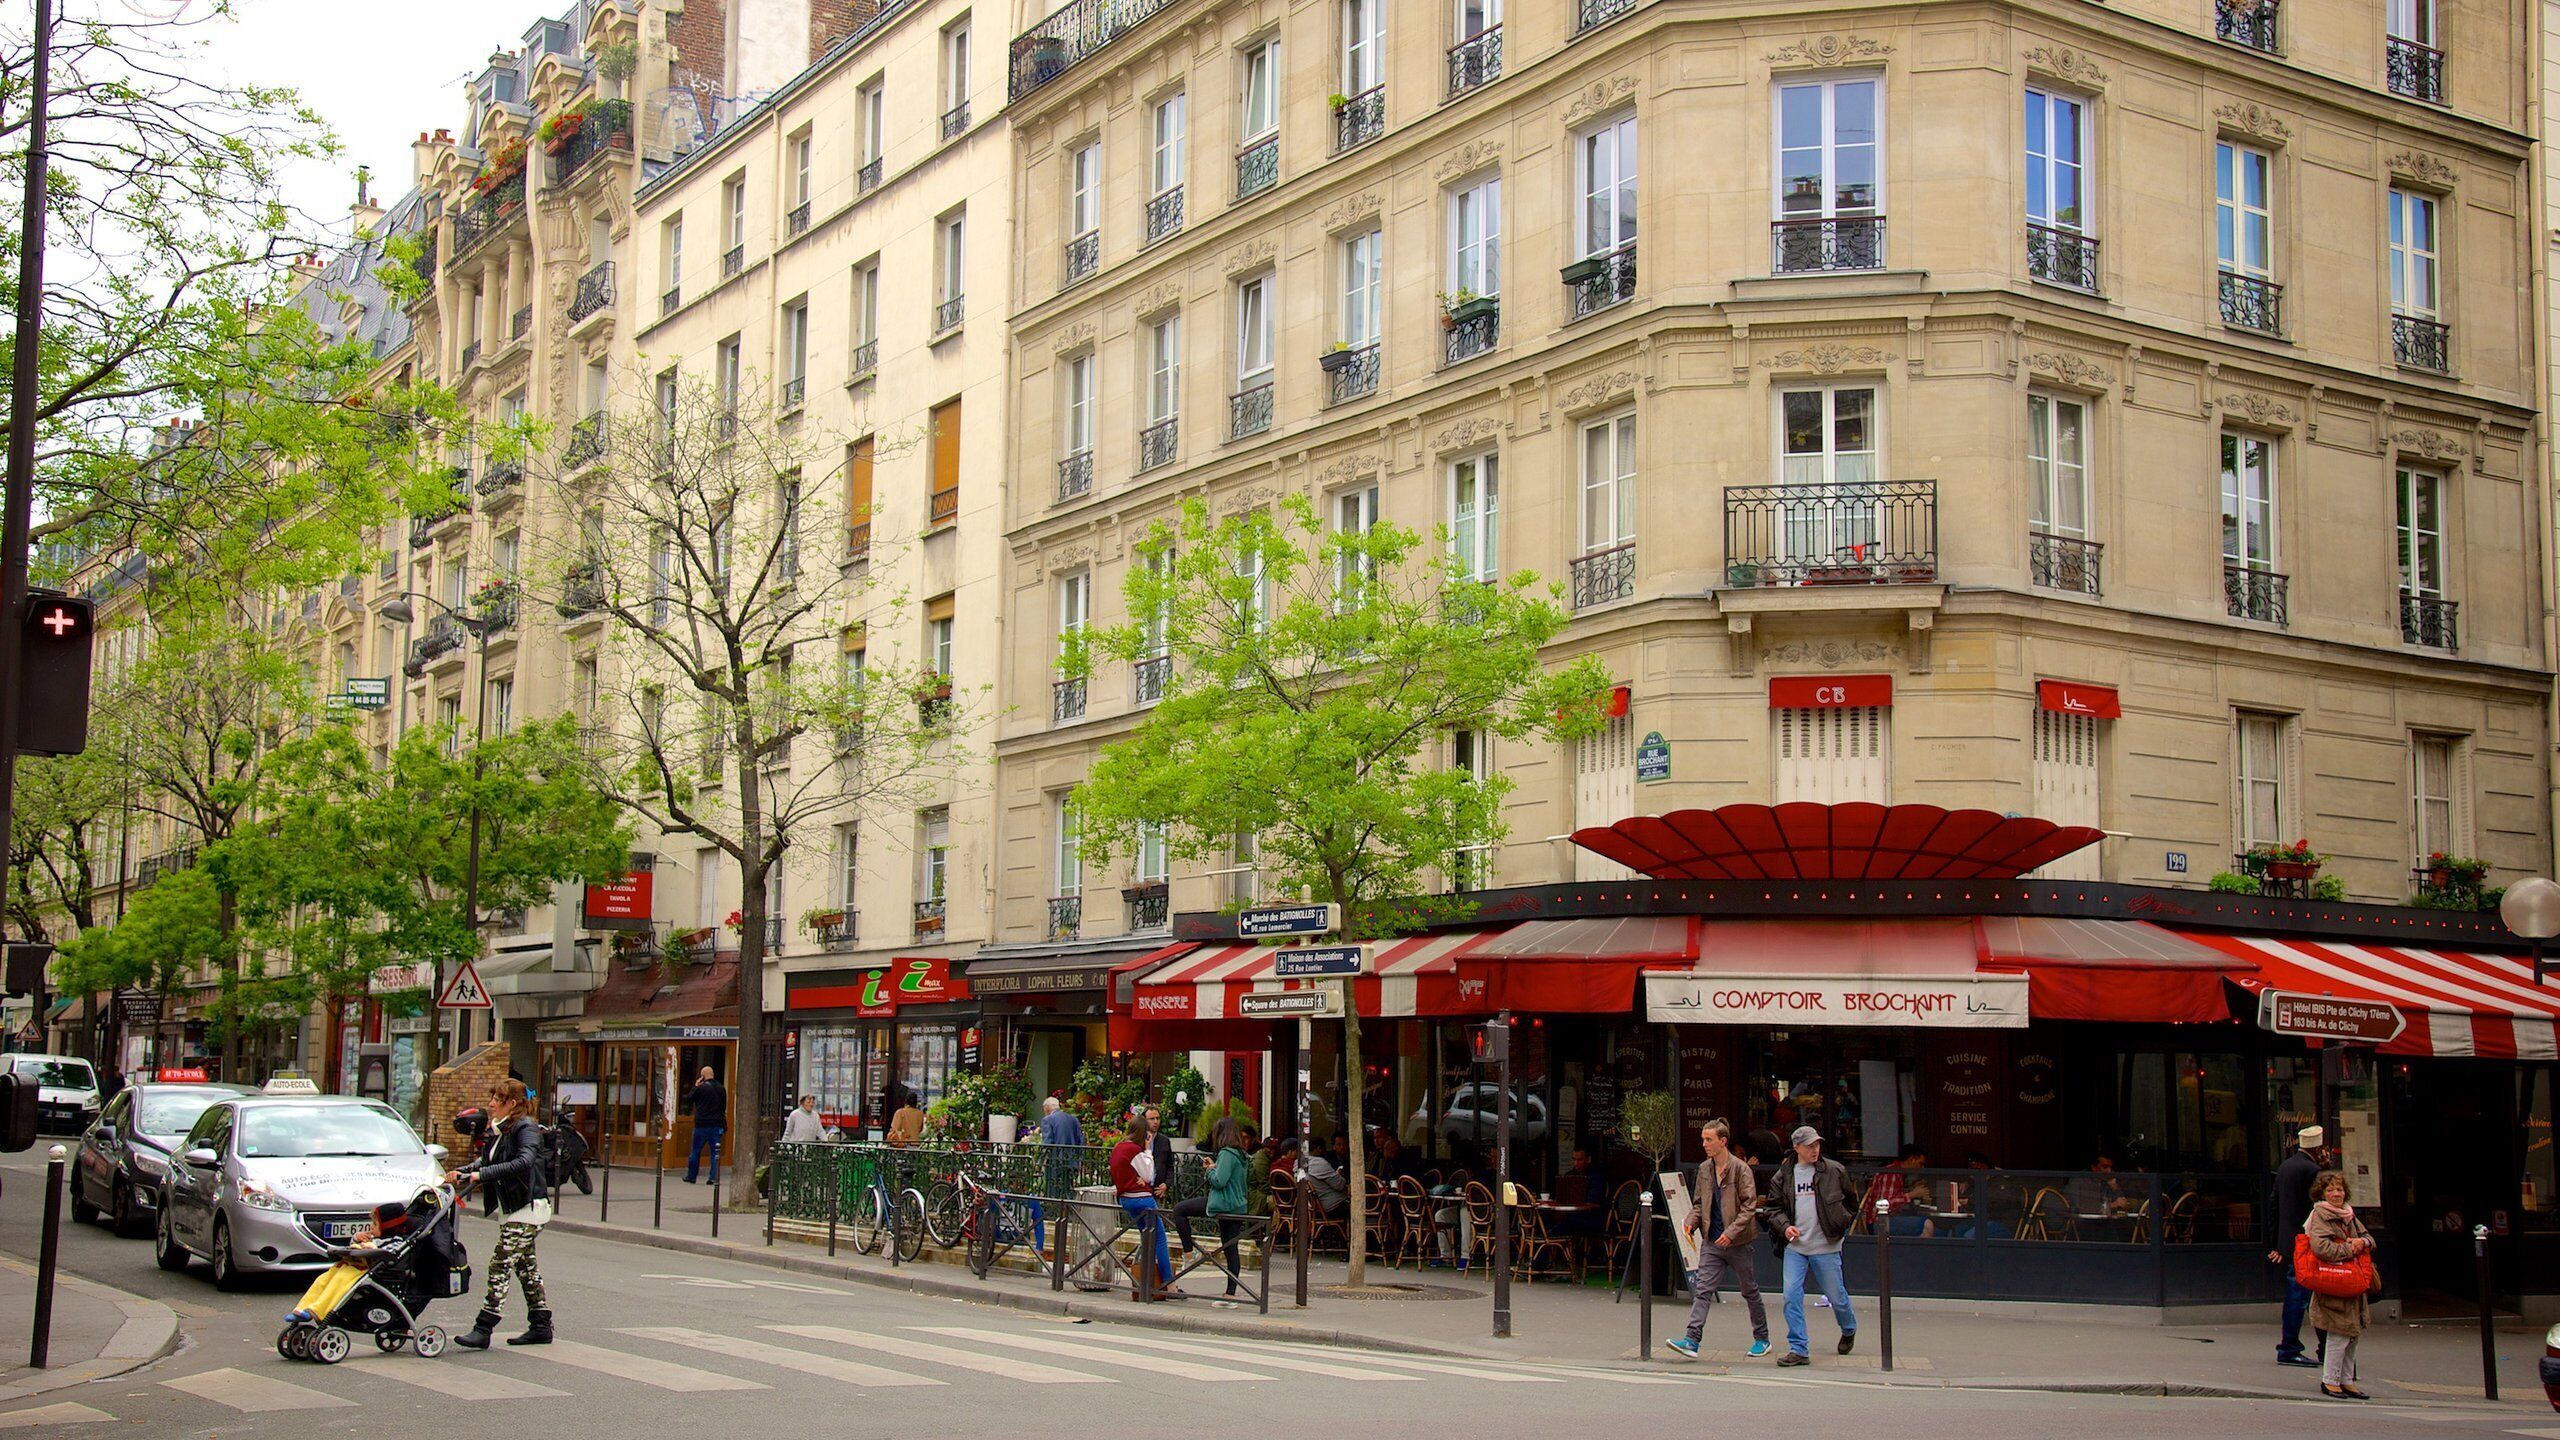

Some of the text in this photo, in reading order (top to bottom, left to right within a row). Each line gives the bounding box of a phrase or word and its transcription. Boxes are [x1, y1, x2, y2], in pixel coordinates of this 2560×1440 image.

[1815, 686, 1847, 704] CB
[1647, 749, 1659, 757] RUE
[1638, 755, 1667, 766] BROCHANT
[2168, 853, 2186, 871] 129
[1251, 909, 1315, 923] Marché des BATIGNOLLES
[1268, 923, 1292, 931] Lemercier
[1288, 952, 1343, 962] Maison des Associations
[376, 965, 418, 988] PRESSING
[974, 977, 1021, 992] INTERFLORA
[1027, 975, 1055, 989] LOPHYL
[1056, 974, 1084, 988] FLEURS
[1251, 998, 1314, 1011] Square des BATIGNOLLES
[1713, 989, 1957, 1021] COMPTOIR BROCHANT
[2293, 1002, 2391, 1021] Hôtel IBIS Pte de Clichy 17ème
[2293, 1017, 2360, 1034] 163 bis Av. de Clichy
[683, 1027, 728, 1038] PIZZERIA
[1680, 1048, 1717, 1060] BISTRO
[1946, 1052, 1988, 1066] CUISINE
[273, 1080, 311, 1088] AUTO-ECOLE
[1684, 1078, 1713, 1089] PARIS
[1943, 1081, 1992, 1096] TRADITION
[1686, 1107, 1712, 1117] HAPPY
[1950, 1112, 1987, 1123] SERVICE
[1688, 1119, 1707, 1129] HOU
[1950, 1124, 1988, 1135] CONTINU
